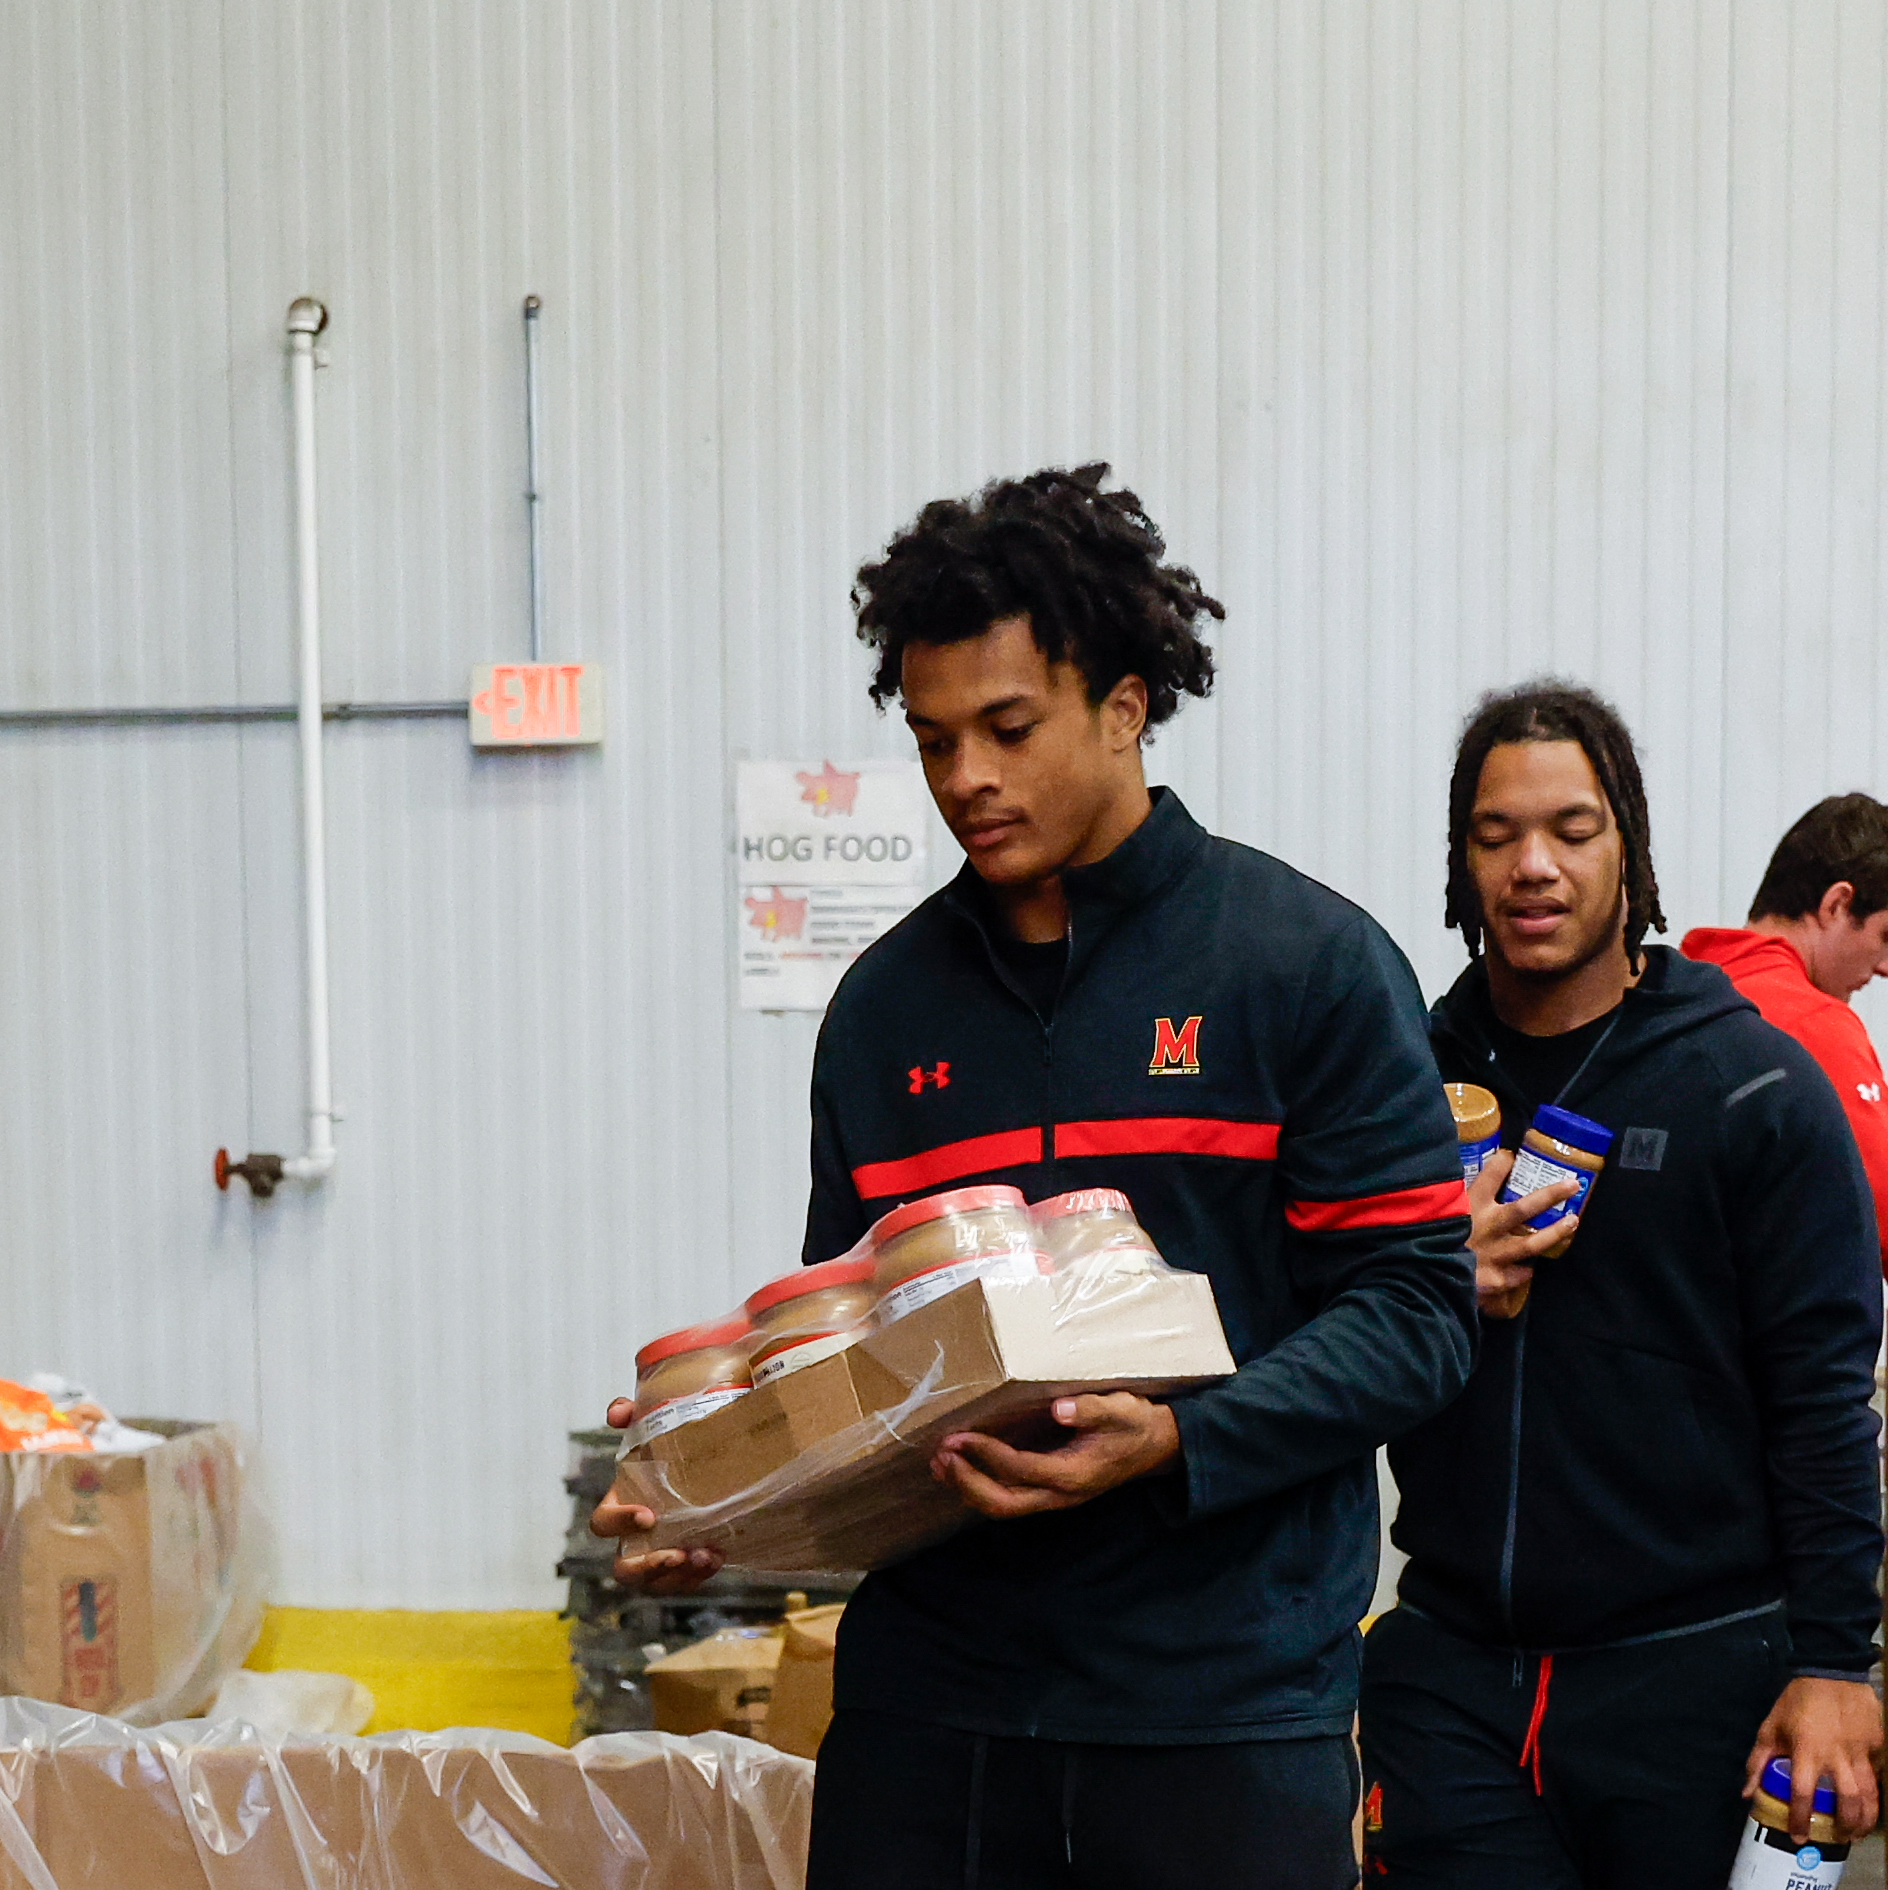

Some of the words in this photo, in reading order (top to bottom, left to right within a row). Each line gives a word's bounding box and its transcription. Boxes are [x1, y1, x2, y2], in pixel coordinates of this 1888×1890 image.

[491, 665, 584, 739] EXIT
[743, 836, 813, 862] HOG
[824, 835, 912, 862] FOOD
[1149, 1016, 1203, 1067] M
